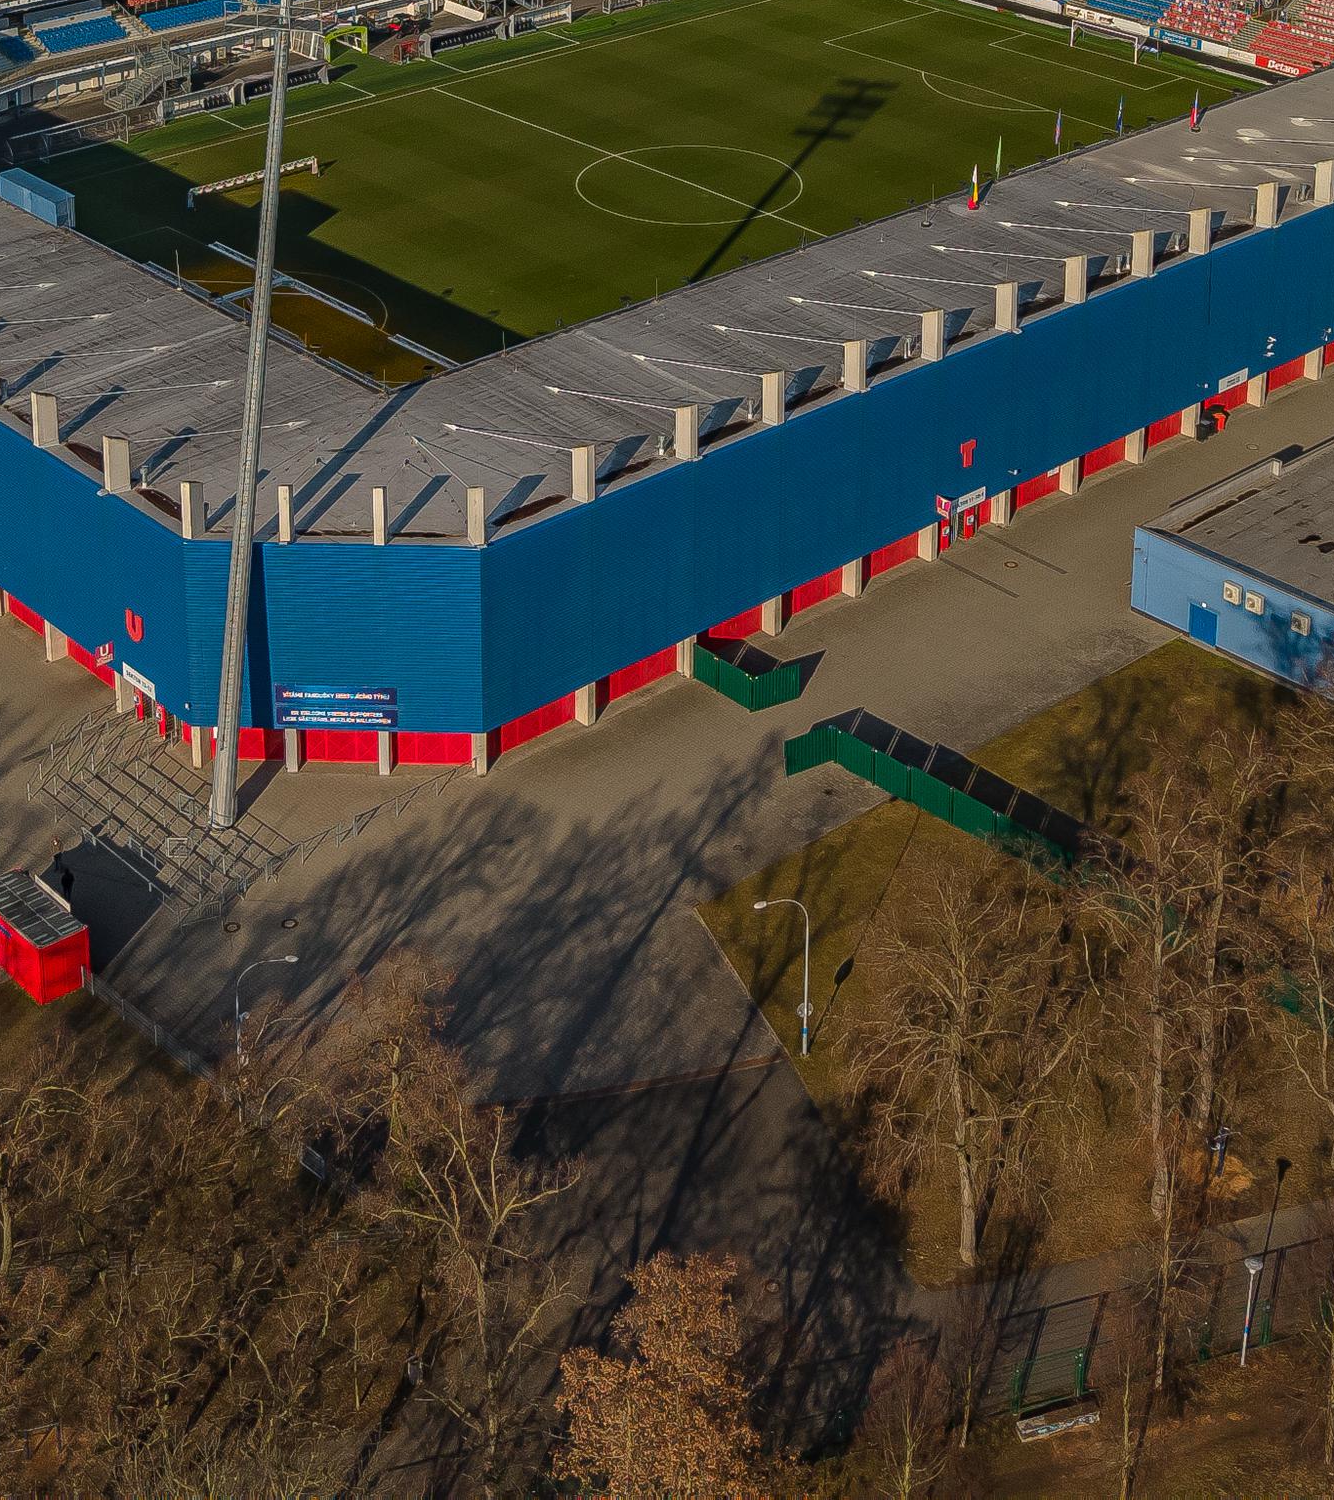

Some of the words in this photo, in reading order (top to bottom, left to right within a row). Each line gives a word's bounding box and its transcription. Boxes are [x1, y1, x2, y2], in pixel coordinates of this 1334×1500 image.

[1268, 59, 1300, 75] Betano
[960, 439, 977, 468] T
[124, 607, 143, 643] U
[99, 643, 109, 657] U
